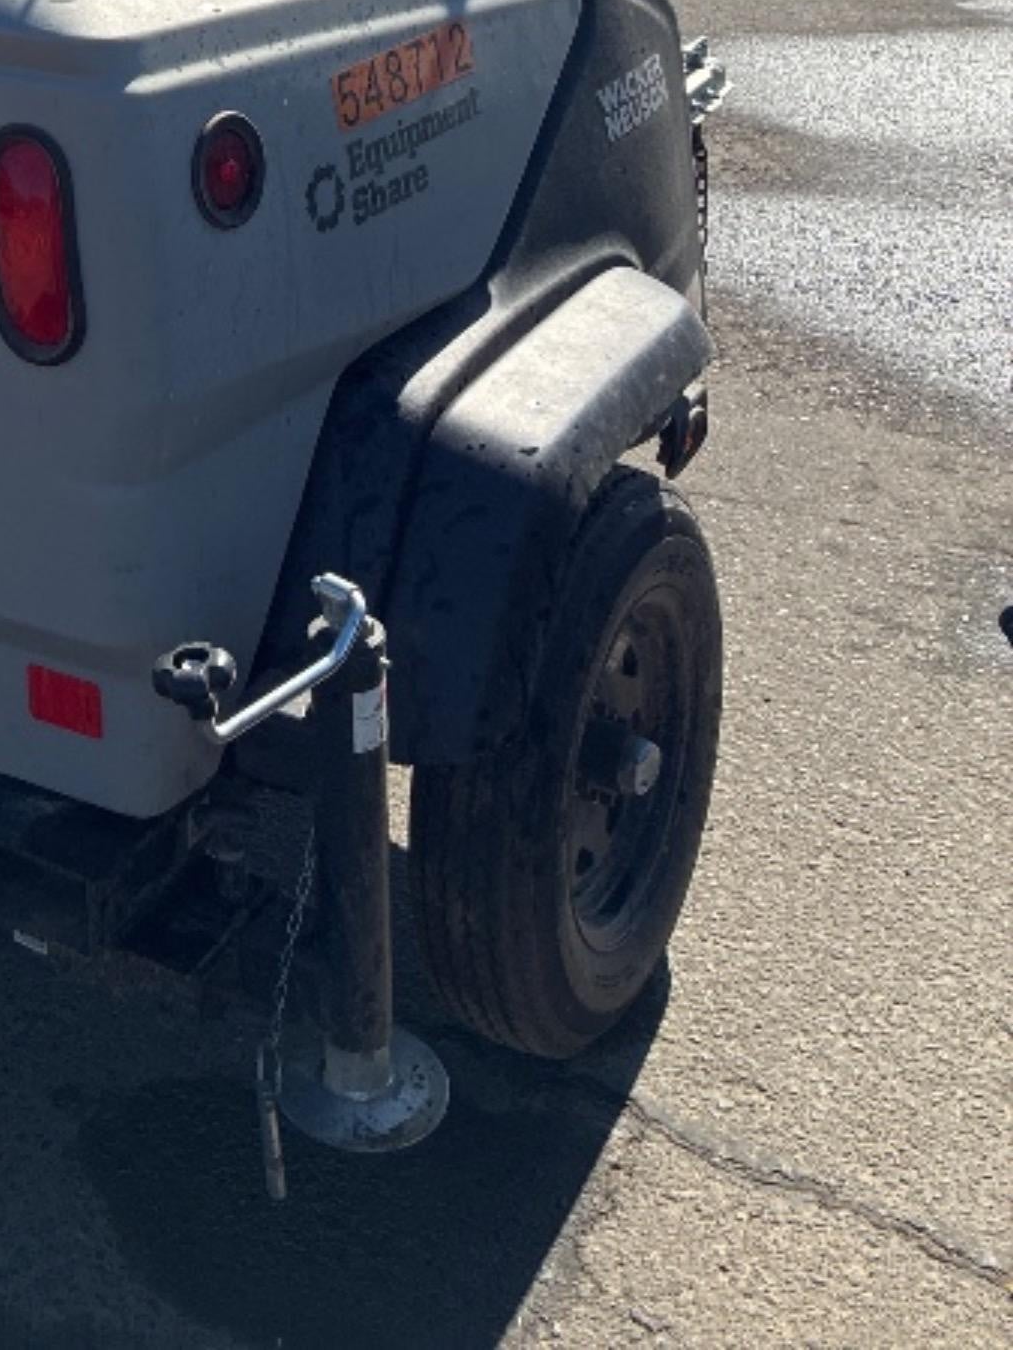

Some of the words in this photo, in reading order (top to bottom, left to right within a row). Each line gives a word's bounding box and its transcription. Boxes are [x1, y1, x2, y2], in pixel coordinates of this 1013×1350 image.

[337, 23, 472, 127] 548712
[346, 86, 482, 182] Equipment
[349, 163, 430, 226] Share
